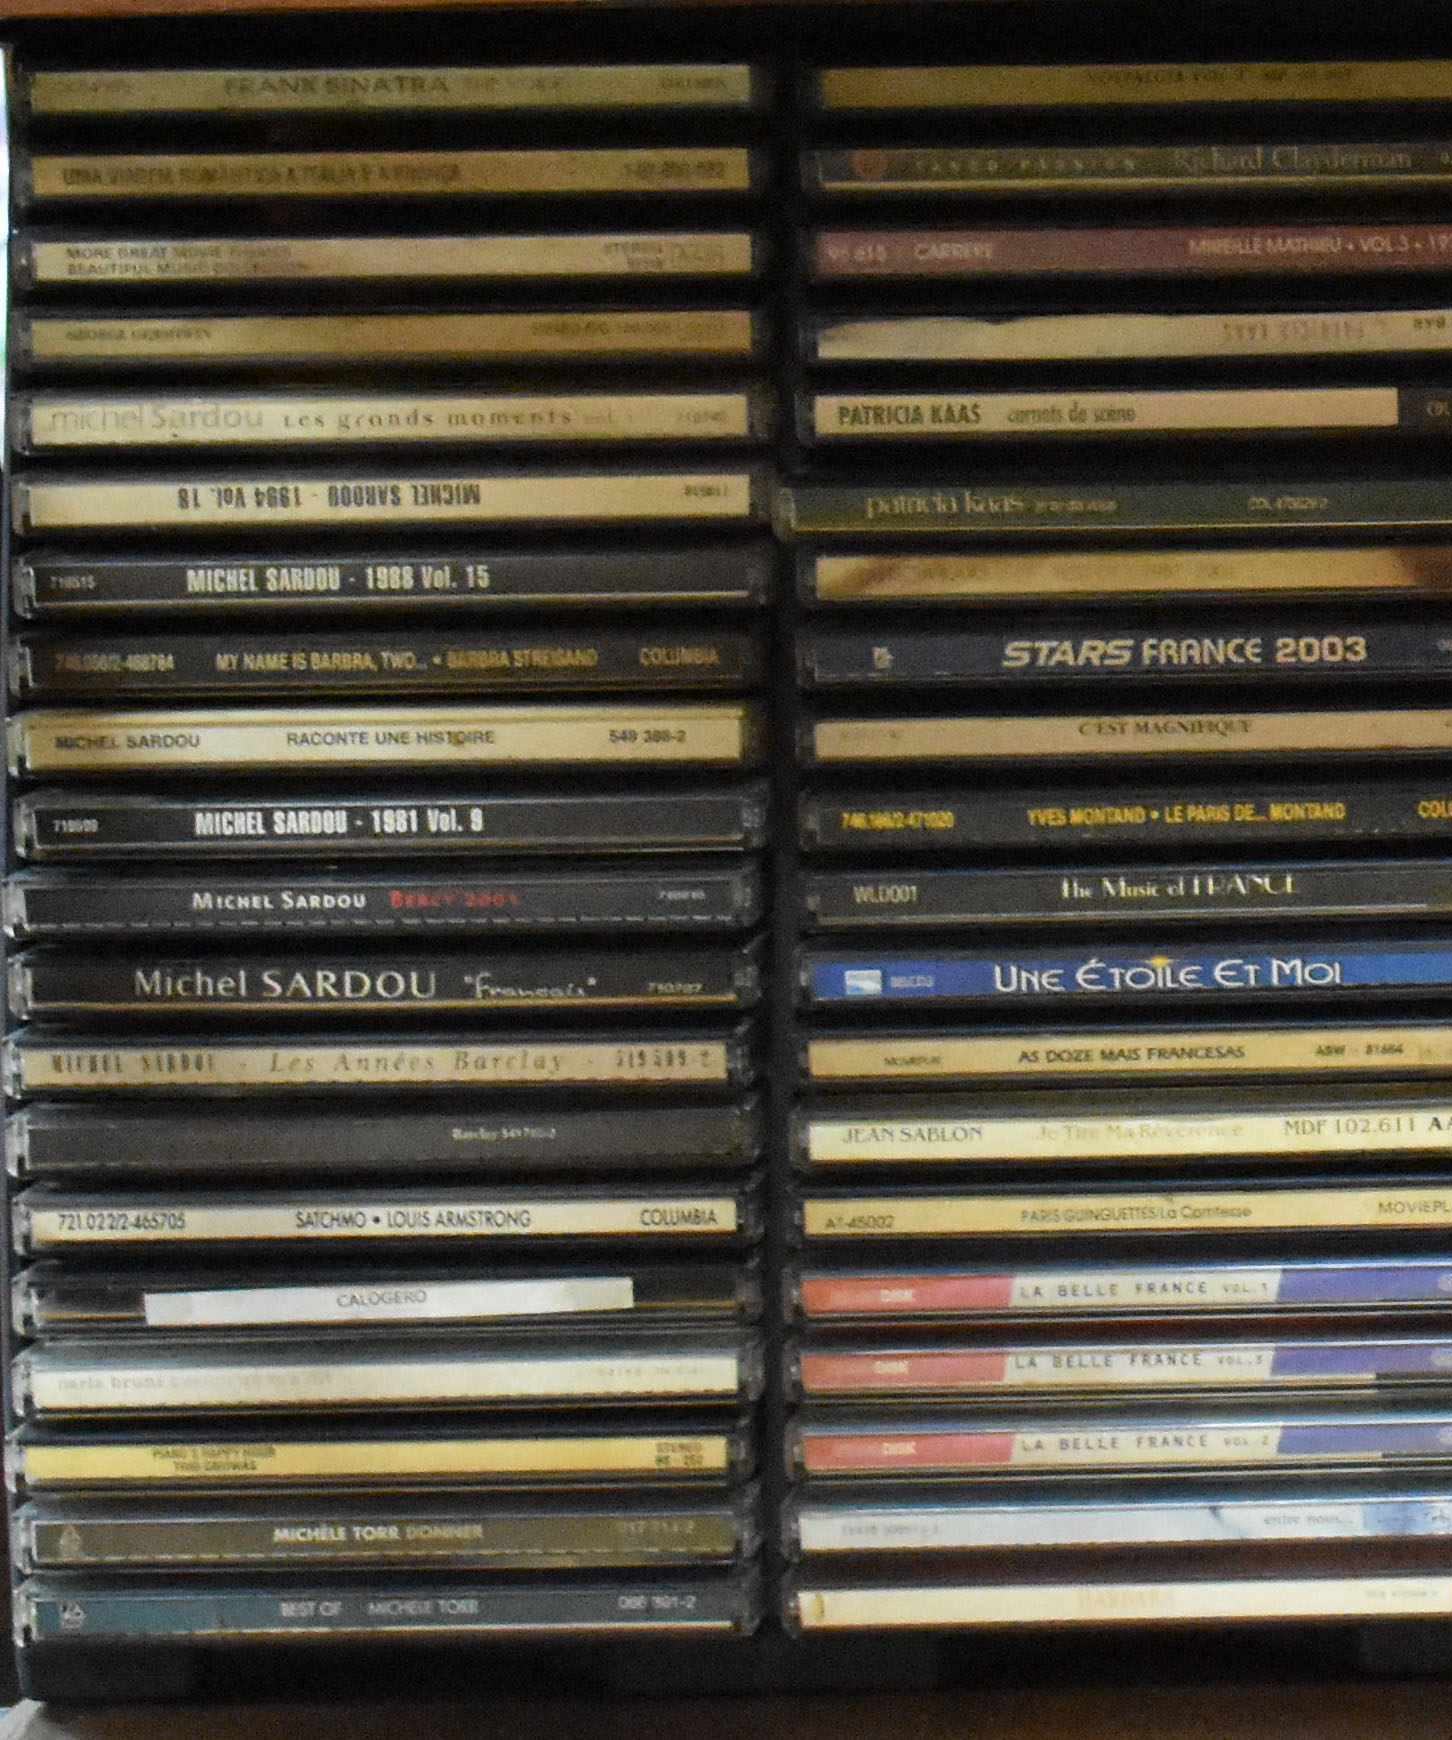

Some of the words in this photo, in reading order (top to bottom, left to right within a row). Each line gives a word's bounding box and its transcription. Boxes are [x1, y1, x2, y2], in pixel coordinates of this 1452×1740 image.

[224, 78, 319, 96] FRANK
[326, 75, 450, 94] SINATRA
[839, 403, 924, 427] PATRICIA
[931, 402, 981, 425] KAAS
[1008, 403, 1062, 424] carnets
[1068, 401, 1087, 424] de
[187, 569, 258, 592] MICHEL
[267, 567, 340, 591] SARDOU
[366, 566, 413, 590] 1988
[422, 566, 458, 589] Vol.
[466, 565, 489, 587] 15
[639, 648, 719, 666] COLUMBIA
[1002, 639, 1133, 668] STARS
[1142, 638, 1261, 665] FRANCE
[1274, 637, 1366, 662] 2003
[126, 734, 200, 749] SARDOU
[287, 730, 370, 746] RACONTE
[375, 730, 410, 745] UNE
[416, 729, 495, 744] HISTOIRE
[195, 812, 267, 836] MICHEL
[274, 810, 347, 834] SARDOU
[371, 809, 419, 833] 1981
[427, 809, 464, 832] Vol.
[1102, 876, 1158, 899] Music
[134, 970, 247, 998] Michel
[262, 970, 436, 999] SARDOU
[1018, 1049, 1040, 1063] AS
[1047, 1048, 1094, 1062] DOZE
[1101, 1047, 1141, 1062] MAIS
[1148, 1046, 1244, 1060] FRANCESAS
[842, 1126, 894, 1143] JEAN
[900, 1126, 982, 1141] SABLON
[295, 1208, 367, 1229] SATCHMO
[388, 1208, 430, 1229] LOUIS
[435, 1207, 531, 1229] ARMSTRONG
[640, 1206, 717, 1227] COLUMBIA
[1021, 1210, 1060, 1224] PARIS
[1181, 1205, 1252, 1220] Comtesse
[337, 1288, 427, 1308] CALOGERO
[1019, 1285, 1046, 1299] LA
[1058, 1283, 1119, 1297] BELLE
[1135, 1281, 1207, 1294] FRANCE
[353, 1524, 399, 1540] TORR
